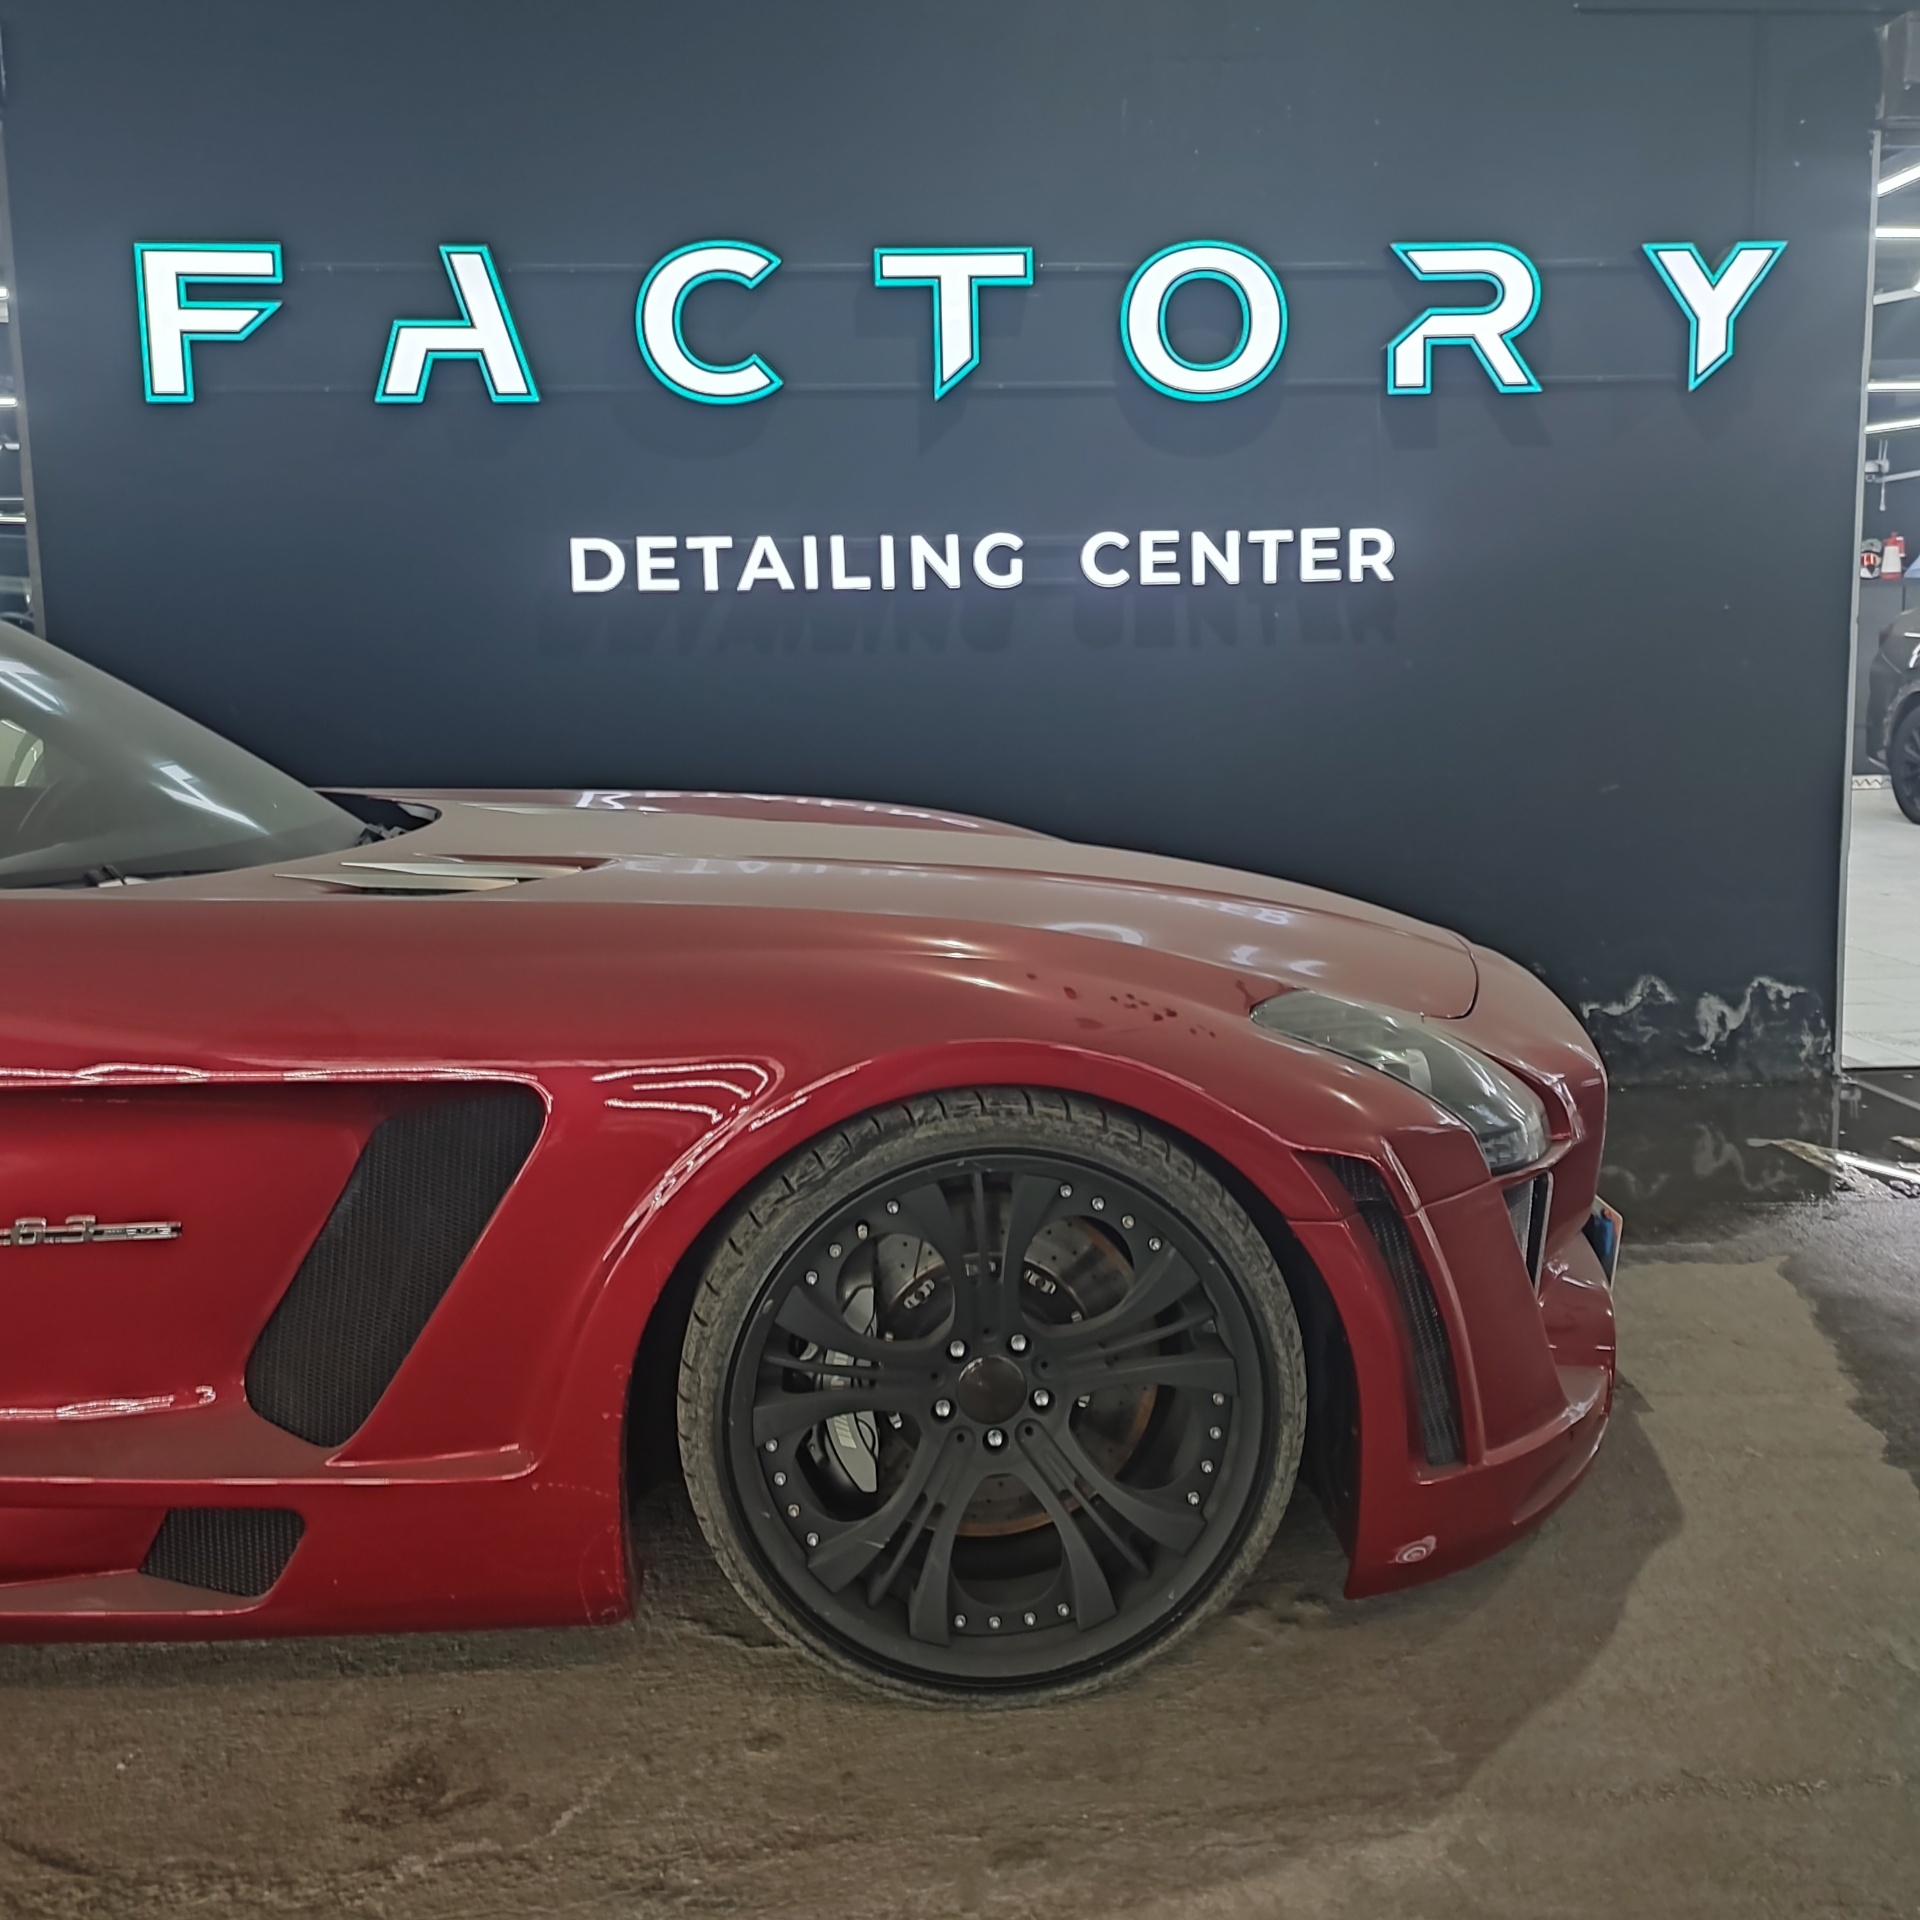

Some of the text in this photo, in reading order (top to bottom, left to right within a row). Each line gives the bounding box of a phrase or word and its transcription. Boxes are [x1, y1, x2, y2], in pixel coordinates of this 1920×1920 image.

[132, 238, 1788, 406] FACTORY
[569, 525, 1397, 594] DETAILING CENTER
